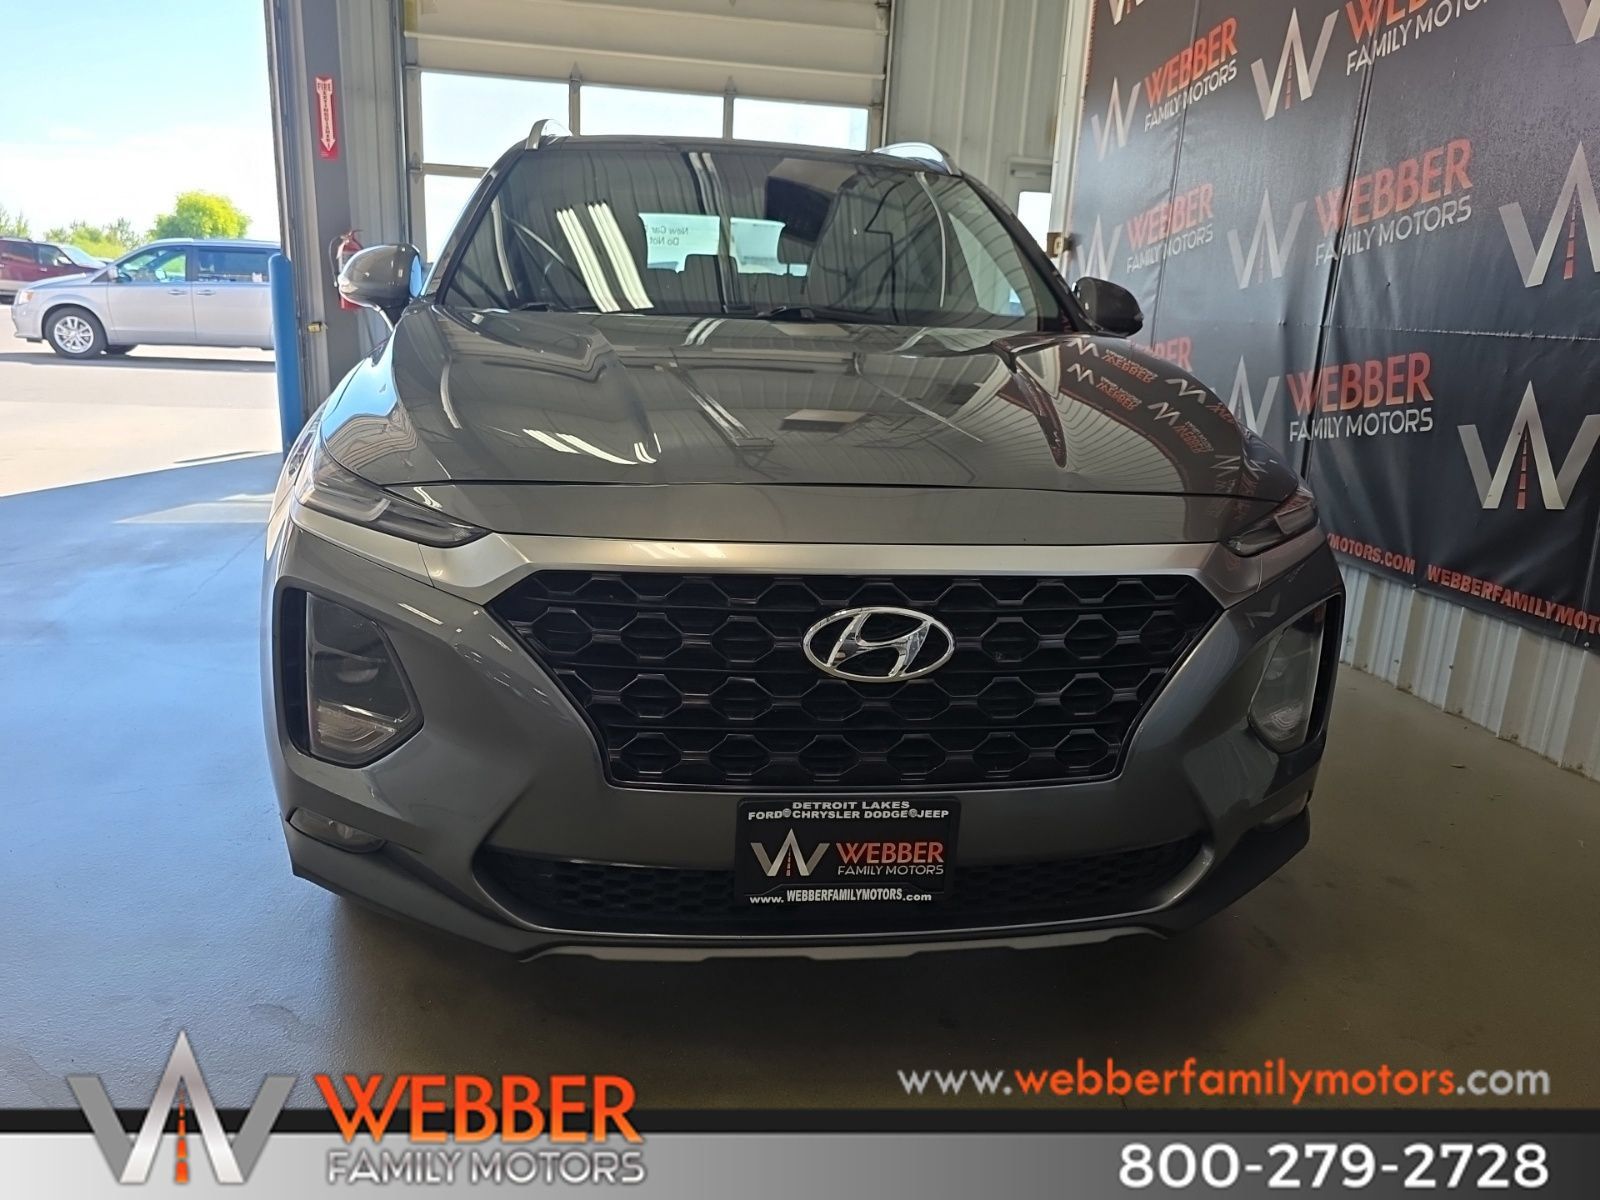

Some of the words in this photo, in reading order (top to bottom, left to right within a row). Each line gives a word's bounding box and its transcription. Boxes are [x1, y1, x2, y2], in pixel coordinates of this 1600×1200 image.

[1144, 17, 1238, 107] WEBBER
[1346, 19, 1412, 76] FAMILY
[1415, 0, 1488, 39] MOT
[1144, 95, 1182, 132] FAMILY
[1183, 59, 1237, 109] MOTORS
[1126, 183, 1213, 251] WEBBER
[1315, 138, 1473, 238] WEBBER
[1127, 244, 1162, 273] FAMILY
[1163, 224, 1213, 259] MOTORS
[1315, 226, 1376, 266] FAMILY
[1379, 195, 1472, 246] MOTORS
[1286, 352, 1434, 417] WEBBER
[1289, 416, 1343, 442] FAMILY
[1346, 407, 1433, 437] MOTORS
[1428, 564, 1600, 634] WEBBERFAMILYMOT
[748, 810, 782, 820] FORD
[792, 810, 860, 818] CHRYSLER
[864, 810, 908, 818] DODGE
[916, 810, 949, 818] JEEP
[792, 801, 857, 809] DETROIT
[862, 800, 910, 809] LAKES
[836, 842, 944, 864] WEBBER
[838, 865, 882, 875] FAMILY
[886, 865, 944, 875] MOTORS
